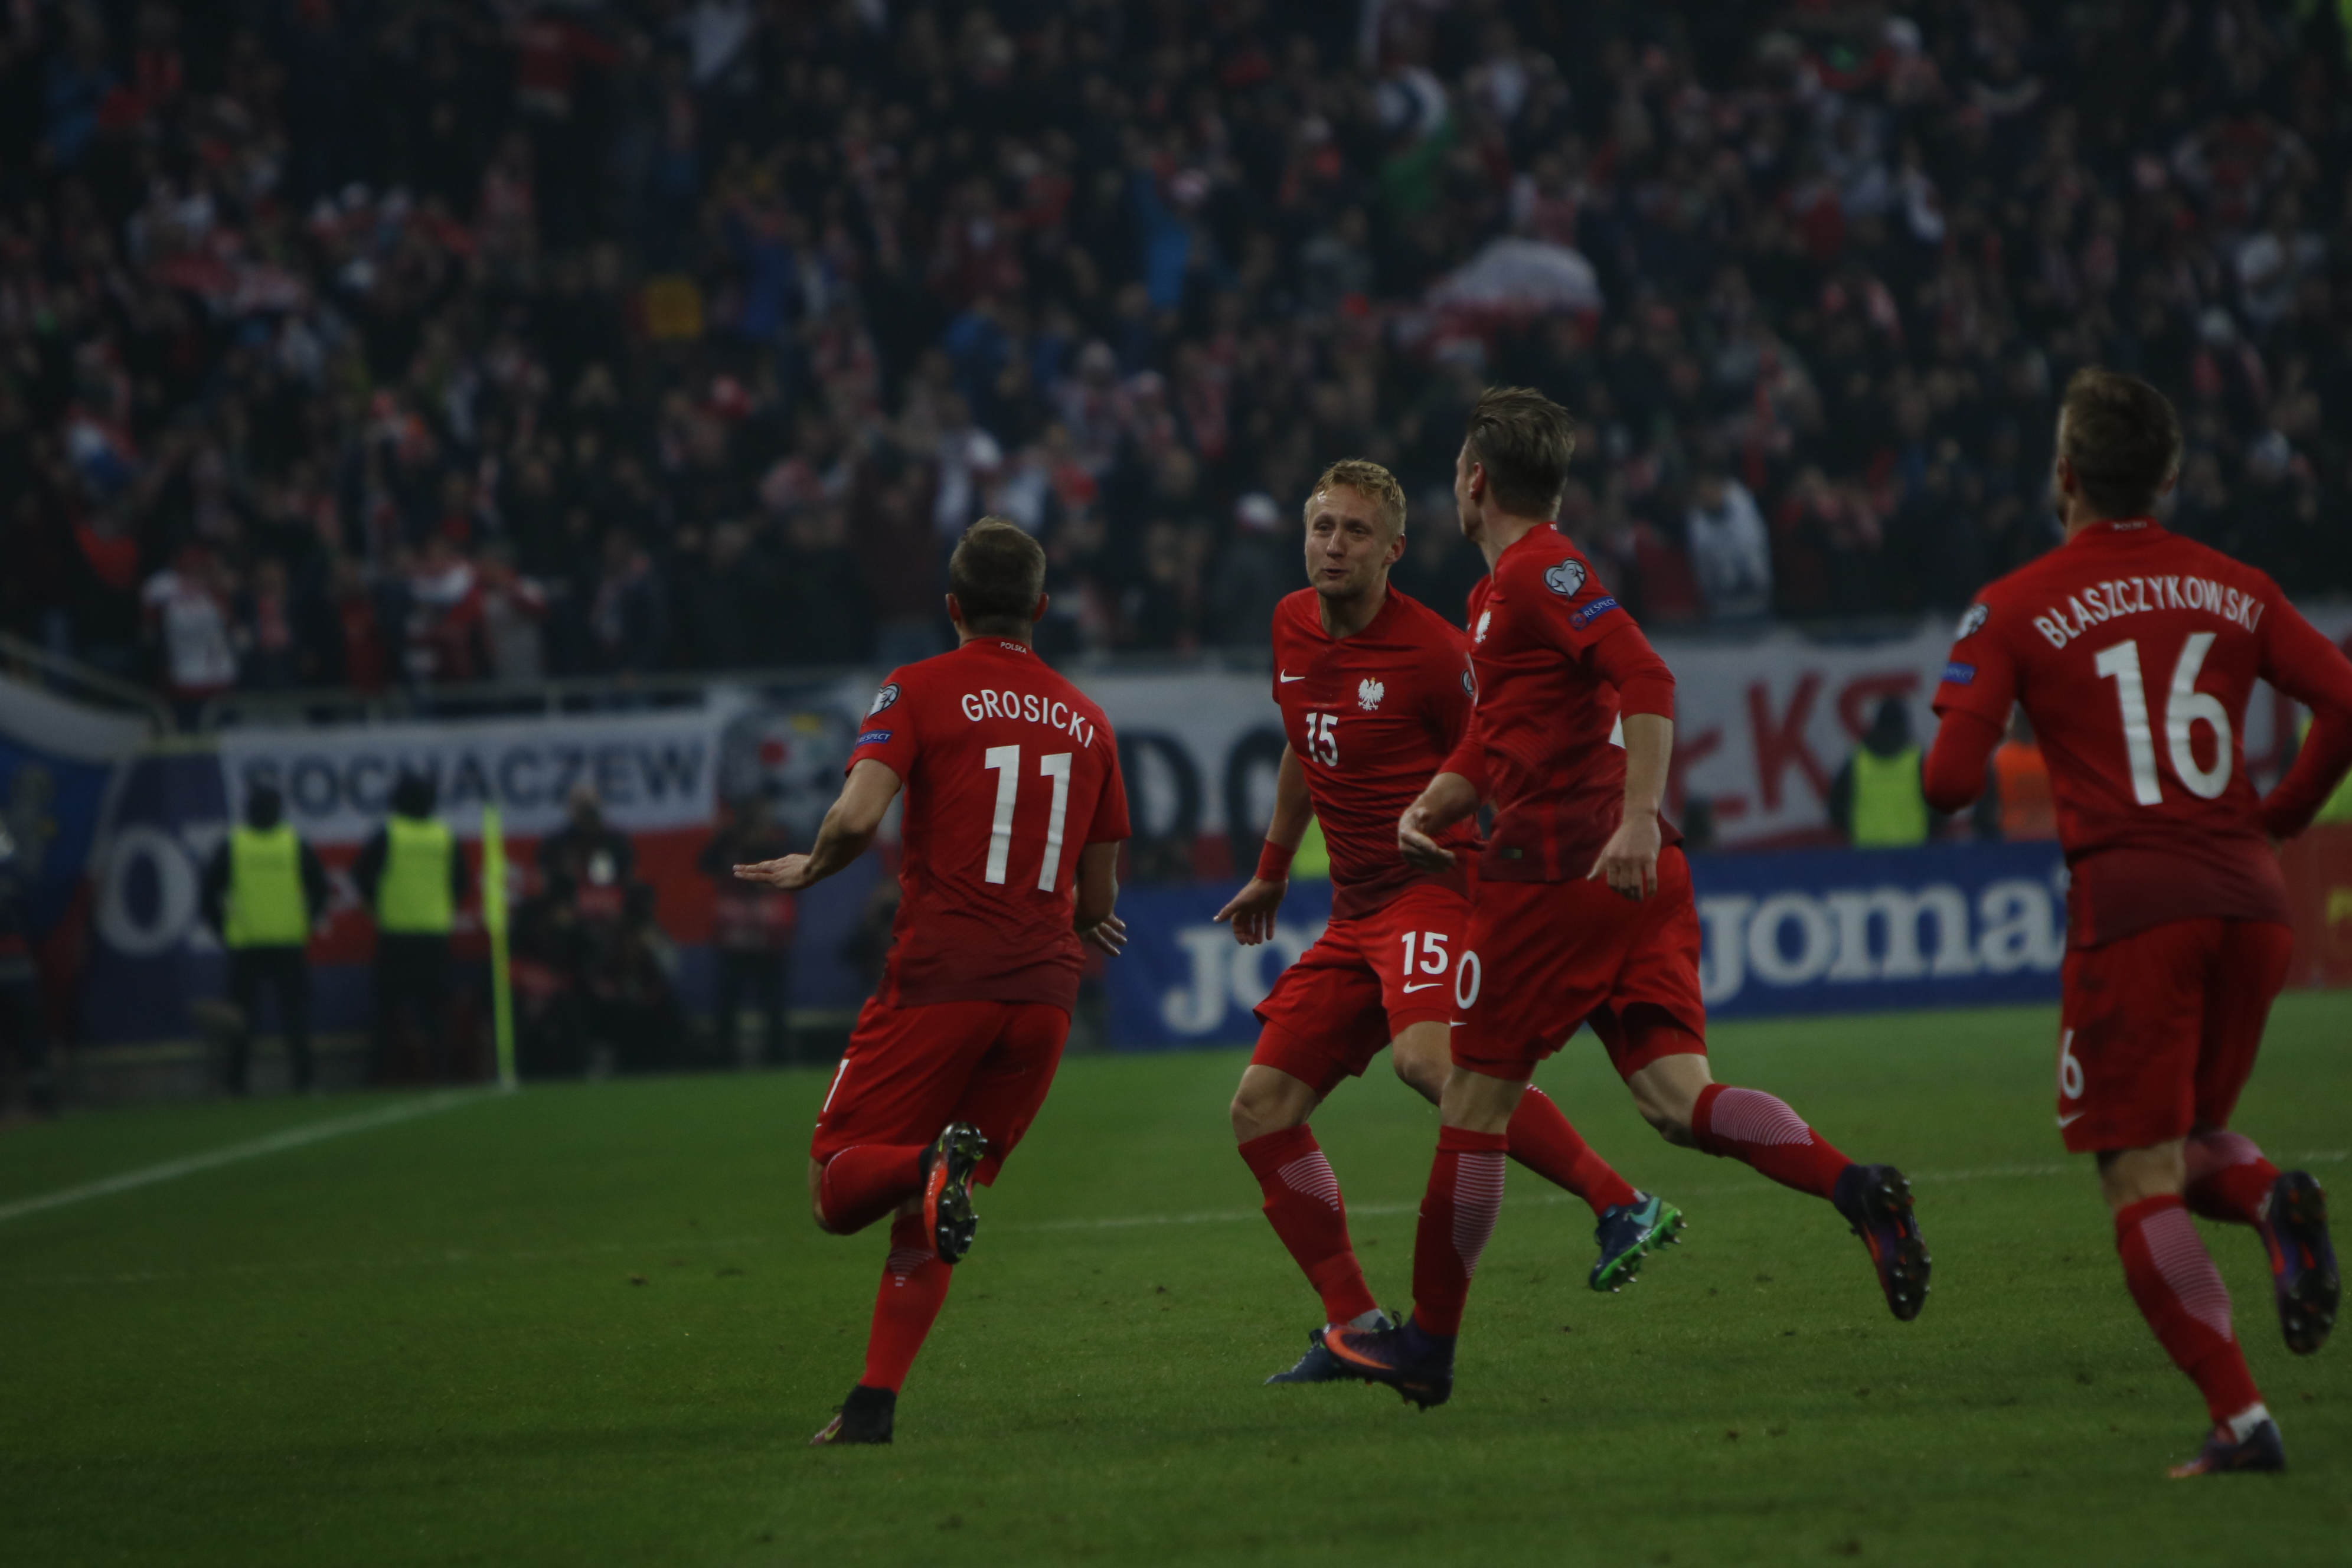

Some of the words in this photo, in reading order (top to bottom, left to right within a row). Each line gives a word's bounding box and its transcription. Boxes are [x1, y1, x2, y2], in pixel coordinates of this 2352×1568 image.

[1584, 599, 1617, 618] RESPECT
[2033, 575, 2265, 649] BŁASZCZYKOWSKI
[1000, 641, 1027, 654] POLSKA
[962, 689, 1093, 748] GROSICKI
[1306, 712, 1338, 767] 15
[2093, 631, 2233, 806] 16
[985, 744, 1072, 892] 11
[1402, 931, 1449, 975] 15
[1455, 950, 1481, 1010] 0
[2059, 1028, 2085, 1100] 6
